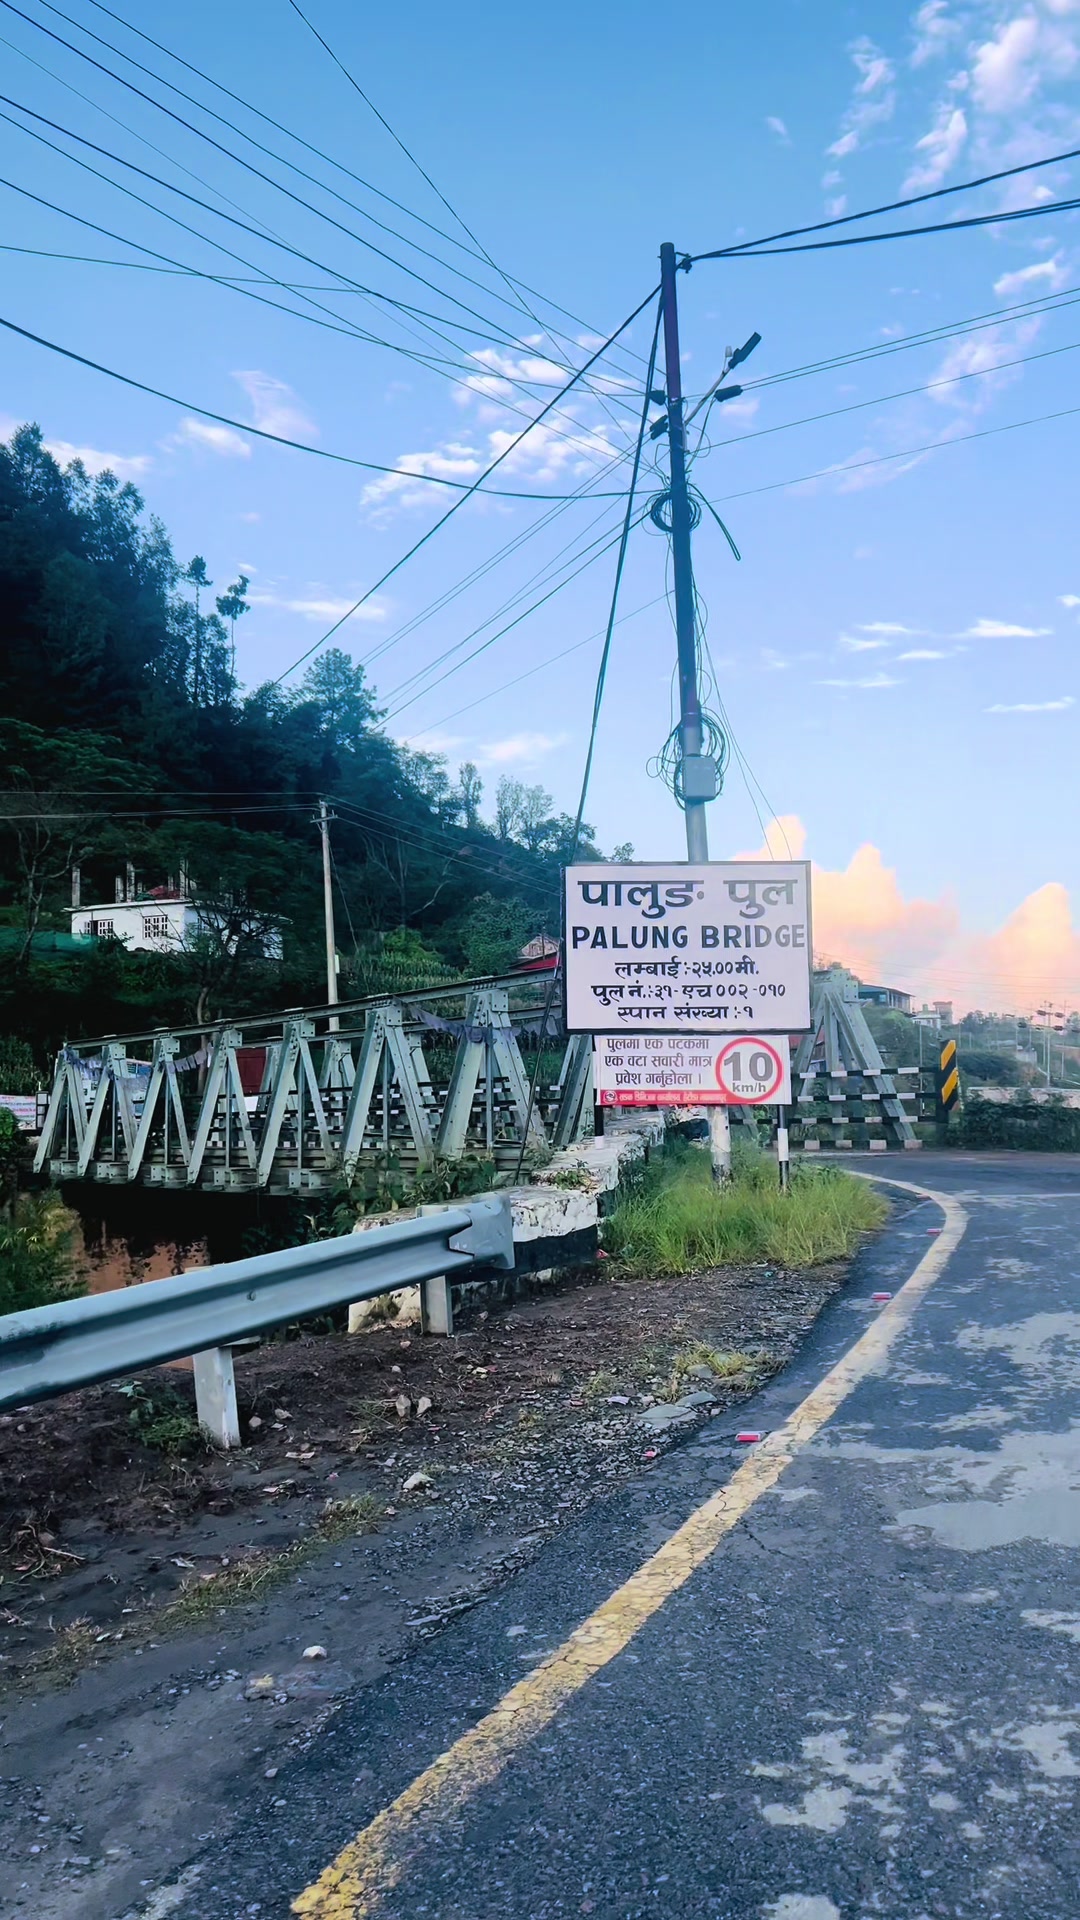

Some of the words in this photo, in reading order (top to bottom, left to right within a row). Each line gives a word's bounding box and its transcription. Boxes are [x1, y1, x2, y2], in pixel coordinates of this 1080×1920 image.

[578, 880, 704, 919] पालुङ
[723, 879, 798, 919] पुल
[572, 926, 688, 950] PALUNG
[701, 924, 806, 948] BRIDGE
[591, 985, 623, 1006] पुल
[618, 1007, 667, 1022] स्पान
[674, 1002, 729, 1021] संख्या
[606, 1038, 640, 1052] पुलमा
[644, 1038, 663, 1050] एक
[668, 1038, 710, 1050] पटकमा
[604, 1056, 624, 1066] एक
[628, 1056, 647, 1066] वटा
[651, 1052, 684, 1068] सवारी
[688, 1056, 712, 1068] मात्र
[724, 1052, 773, 1082] 10
[616, 1070, 641, 1086] प्रवेश
[646, 1069, 692, 1088] गर्नुहोला
[732, 1082, 766, 1092] km/h
